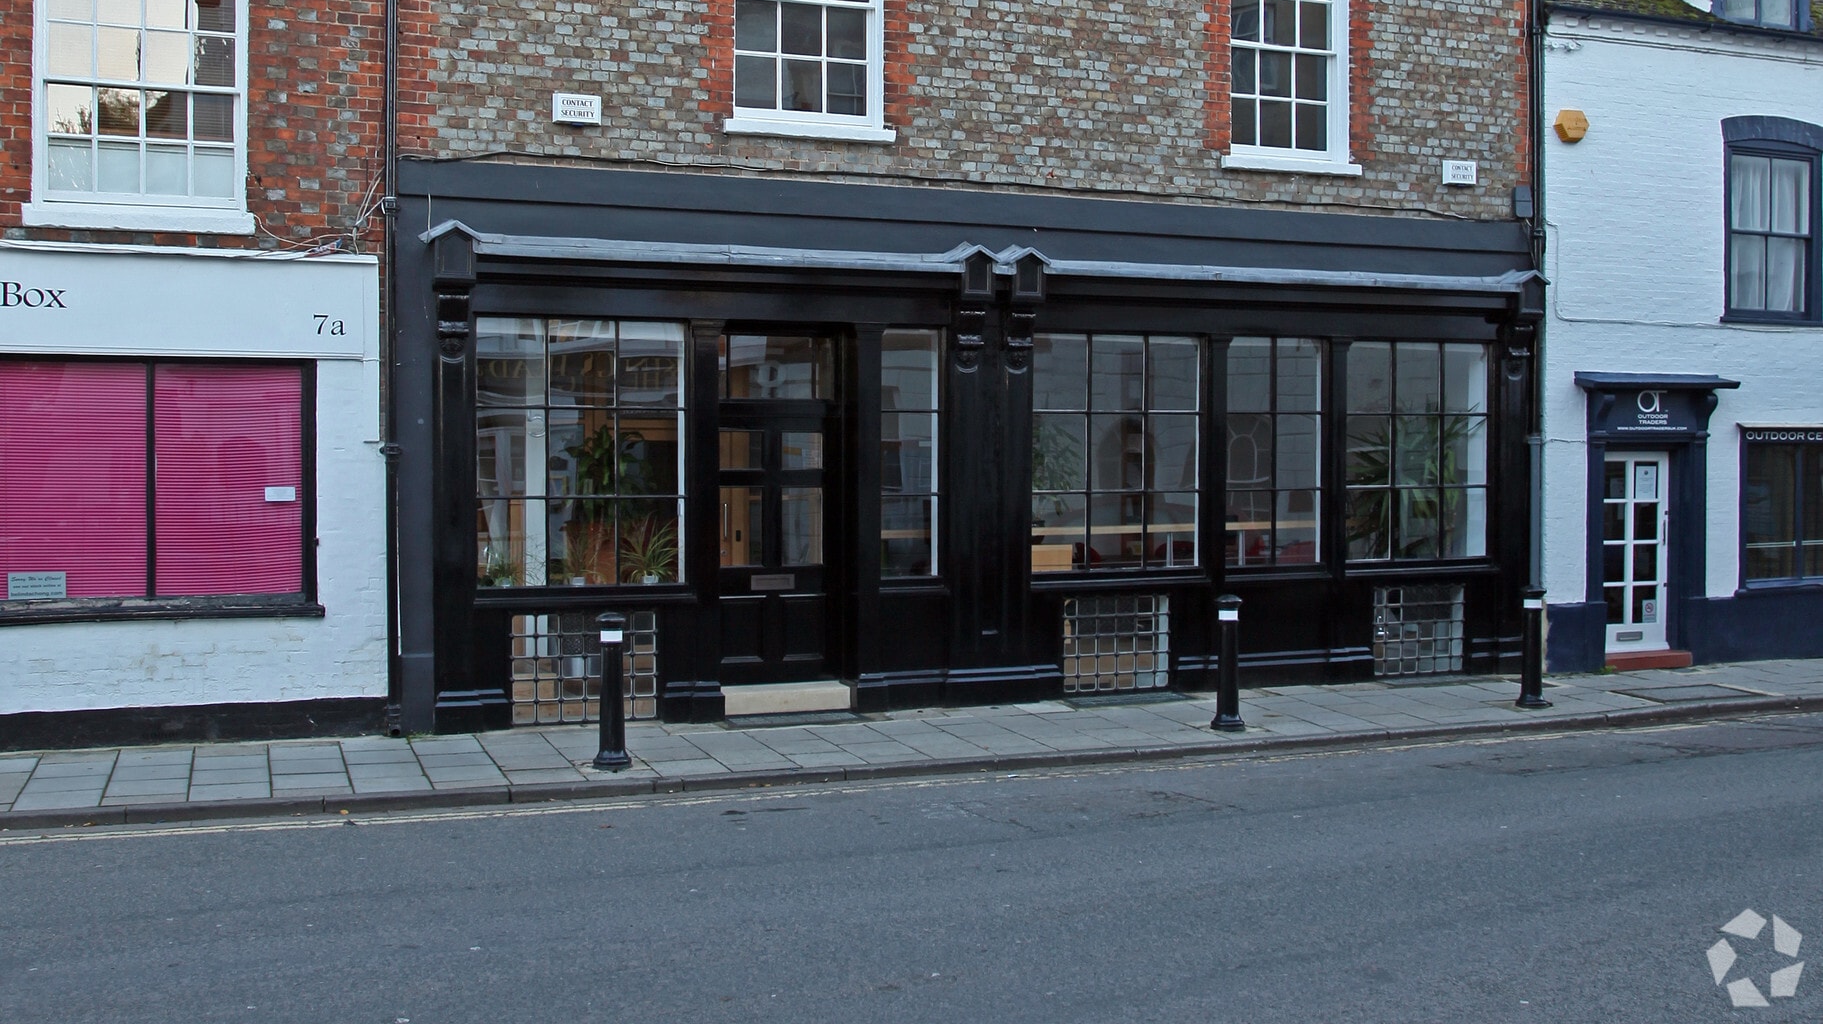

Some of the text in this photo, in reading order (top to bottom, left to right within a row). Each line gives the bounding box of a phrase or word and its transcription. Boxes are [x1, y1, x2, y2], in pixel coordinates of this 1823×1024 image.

[561, 98, 594, 107] CONTACT
[561, 109, 595, 118] SECURITY
[0, 281, 67, 309] Box
[313, 314, 346, 335] 7a
[1745, 431, 1805, 441] OUTDOOR
